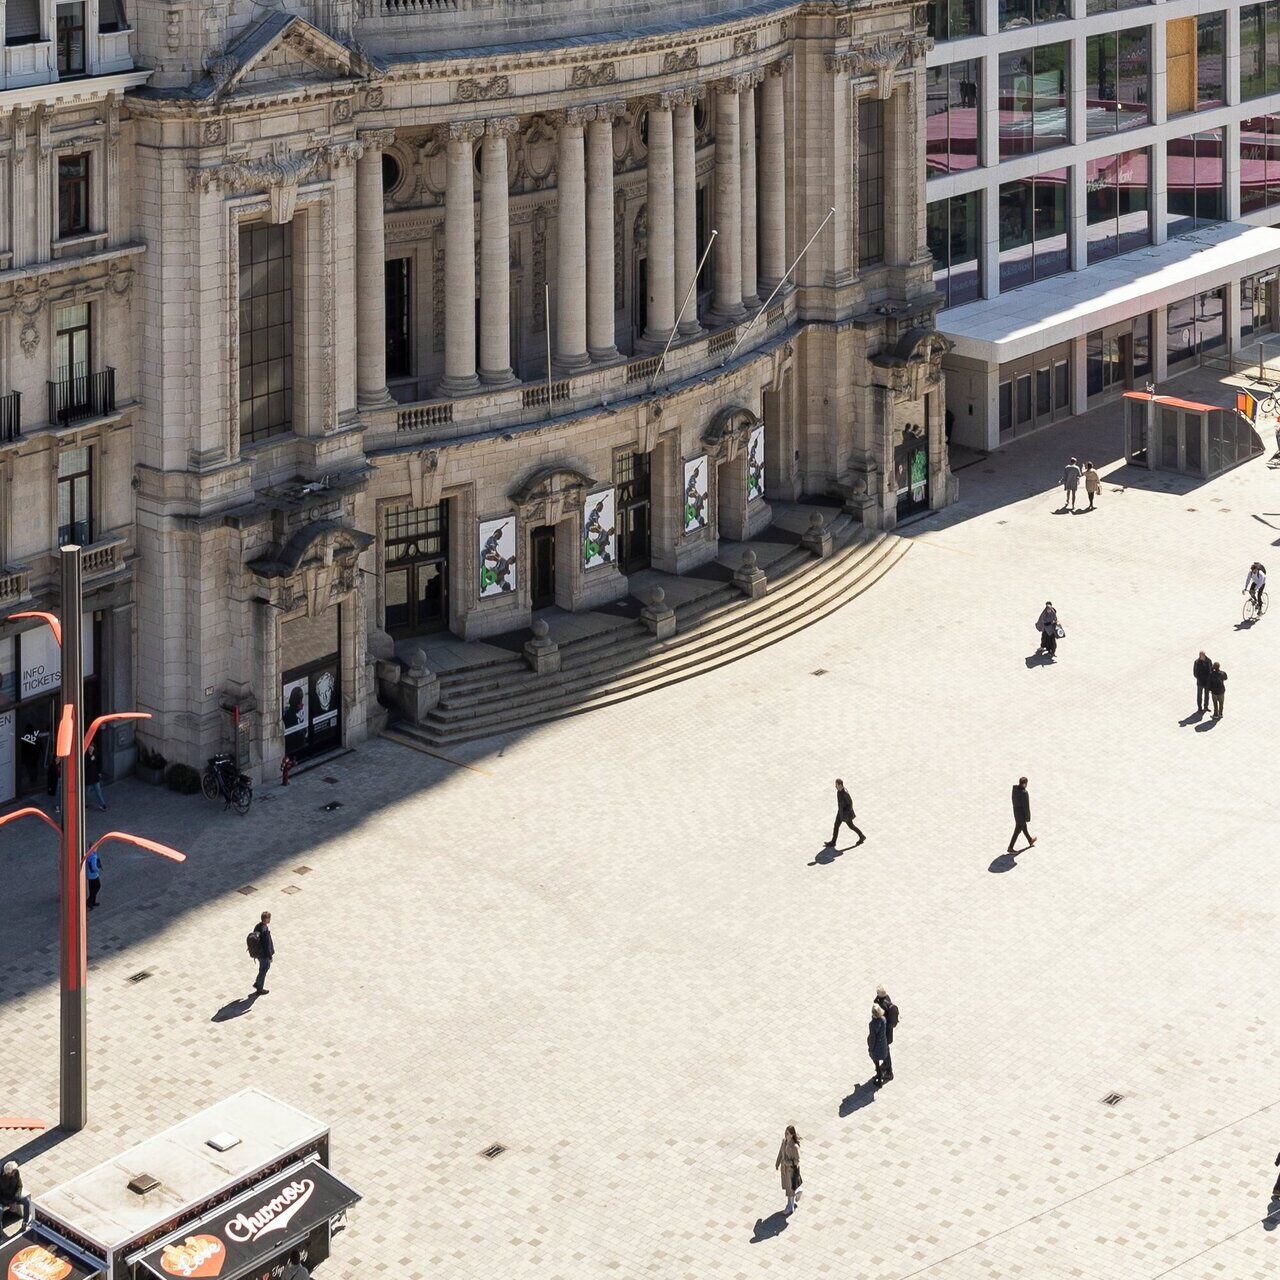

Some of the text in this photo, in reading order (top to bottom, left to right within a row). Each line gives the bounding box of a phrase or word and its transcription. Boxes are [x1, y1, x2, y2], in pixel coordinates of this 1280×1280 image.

[23, 665, 45, 680] INFO
[23, 671, 62, 692] TICKETS
[224, 1179, 315, 1242] Churros
